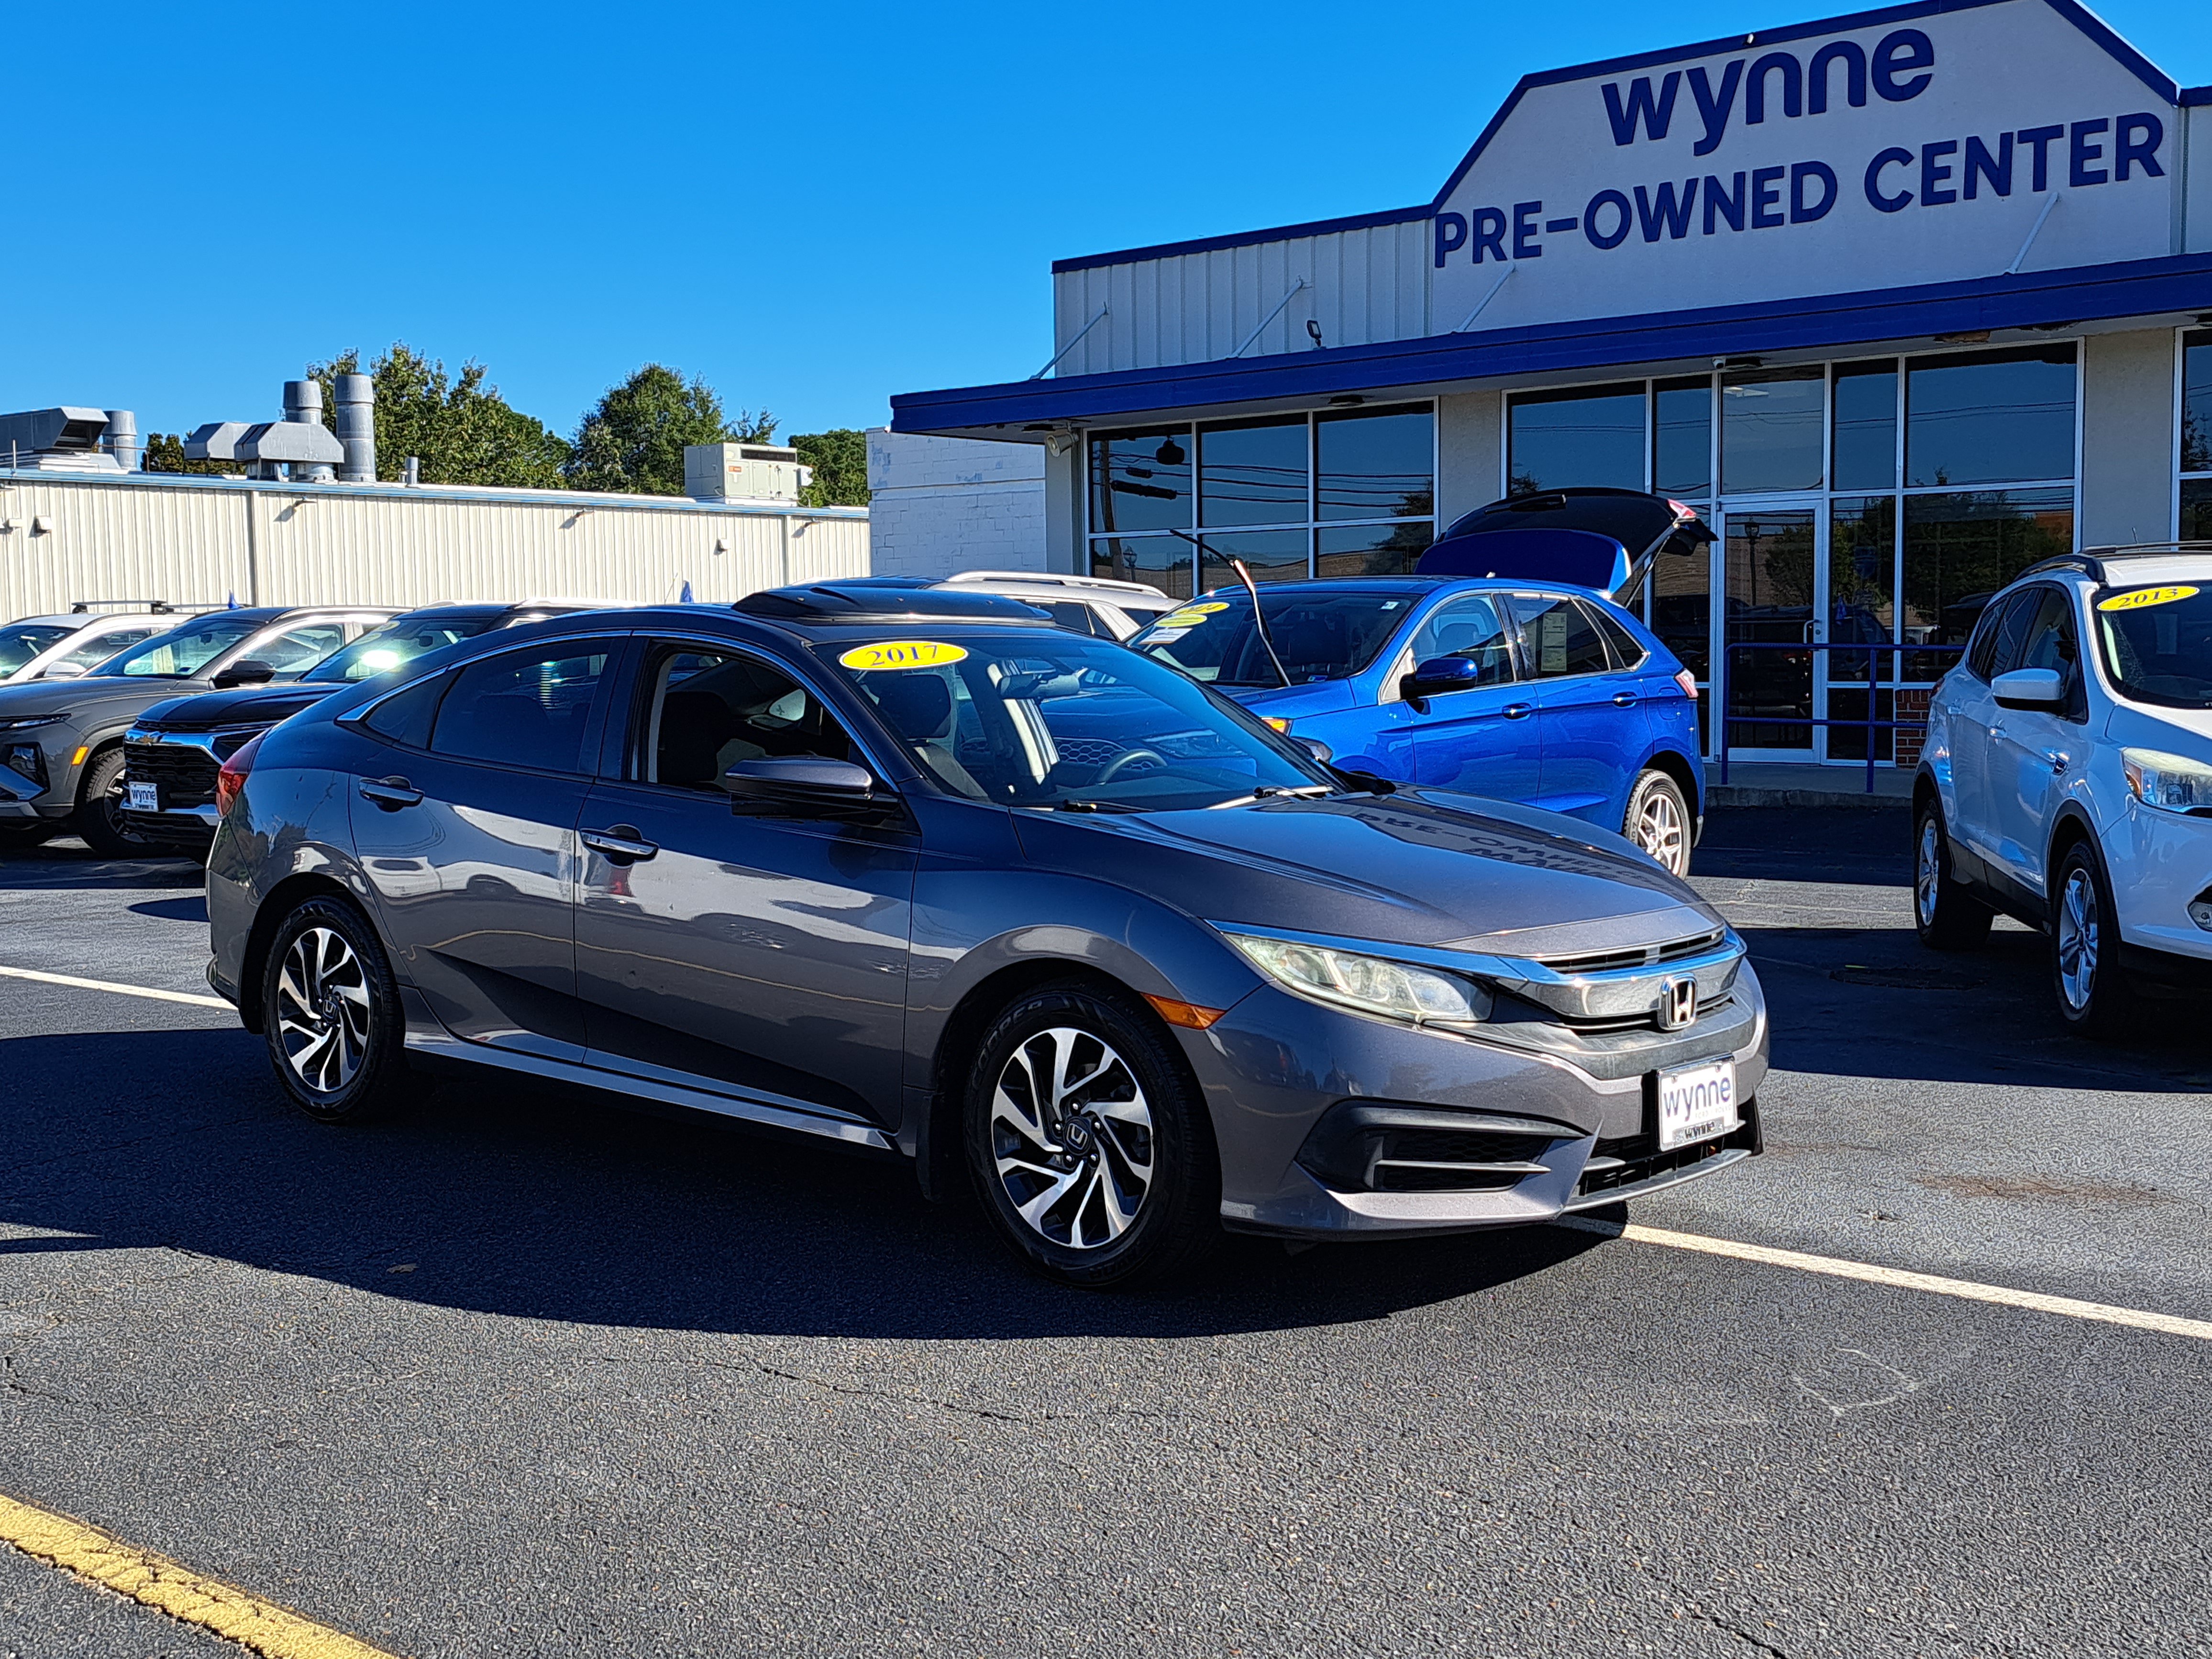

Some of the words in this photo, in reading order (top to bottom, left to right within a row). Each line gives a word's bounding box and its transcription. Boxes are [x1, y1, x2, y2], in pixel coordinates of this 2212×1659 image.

[1601, 28, 1935, 156] wynne
[1435, 160, 1837, 268] PRE-OWNED
[1864, 112, 2166, 214] CENTER
[2117, 588, 2178, 608] 2013
[865, 644, 938, 666] 2017
[132, 789, 156, 803] wynne
[1663, 1077, 1731, 1122] wynne
